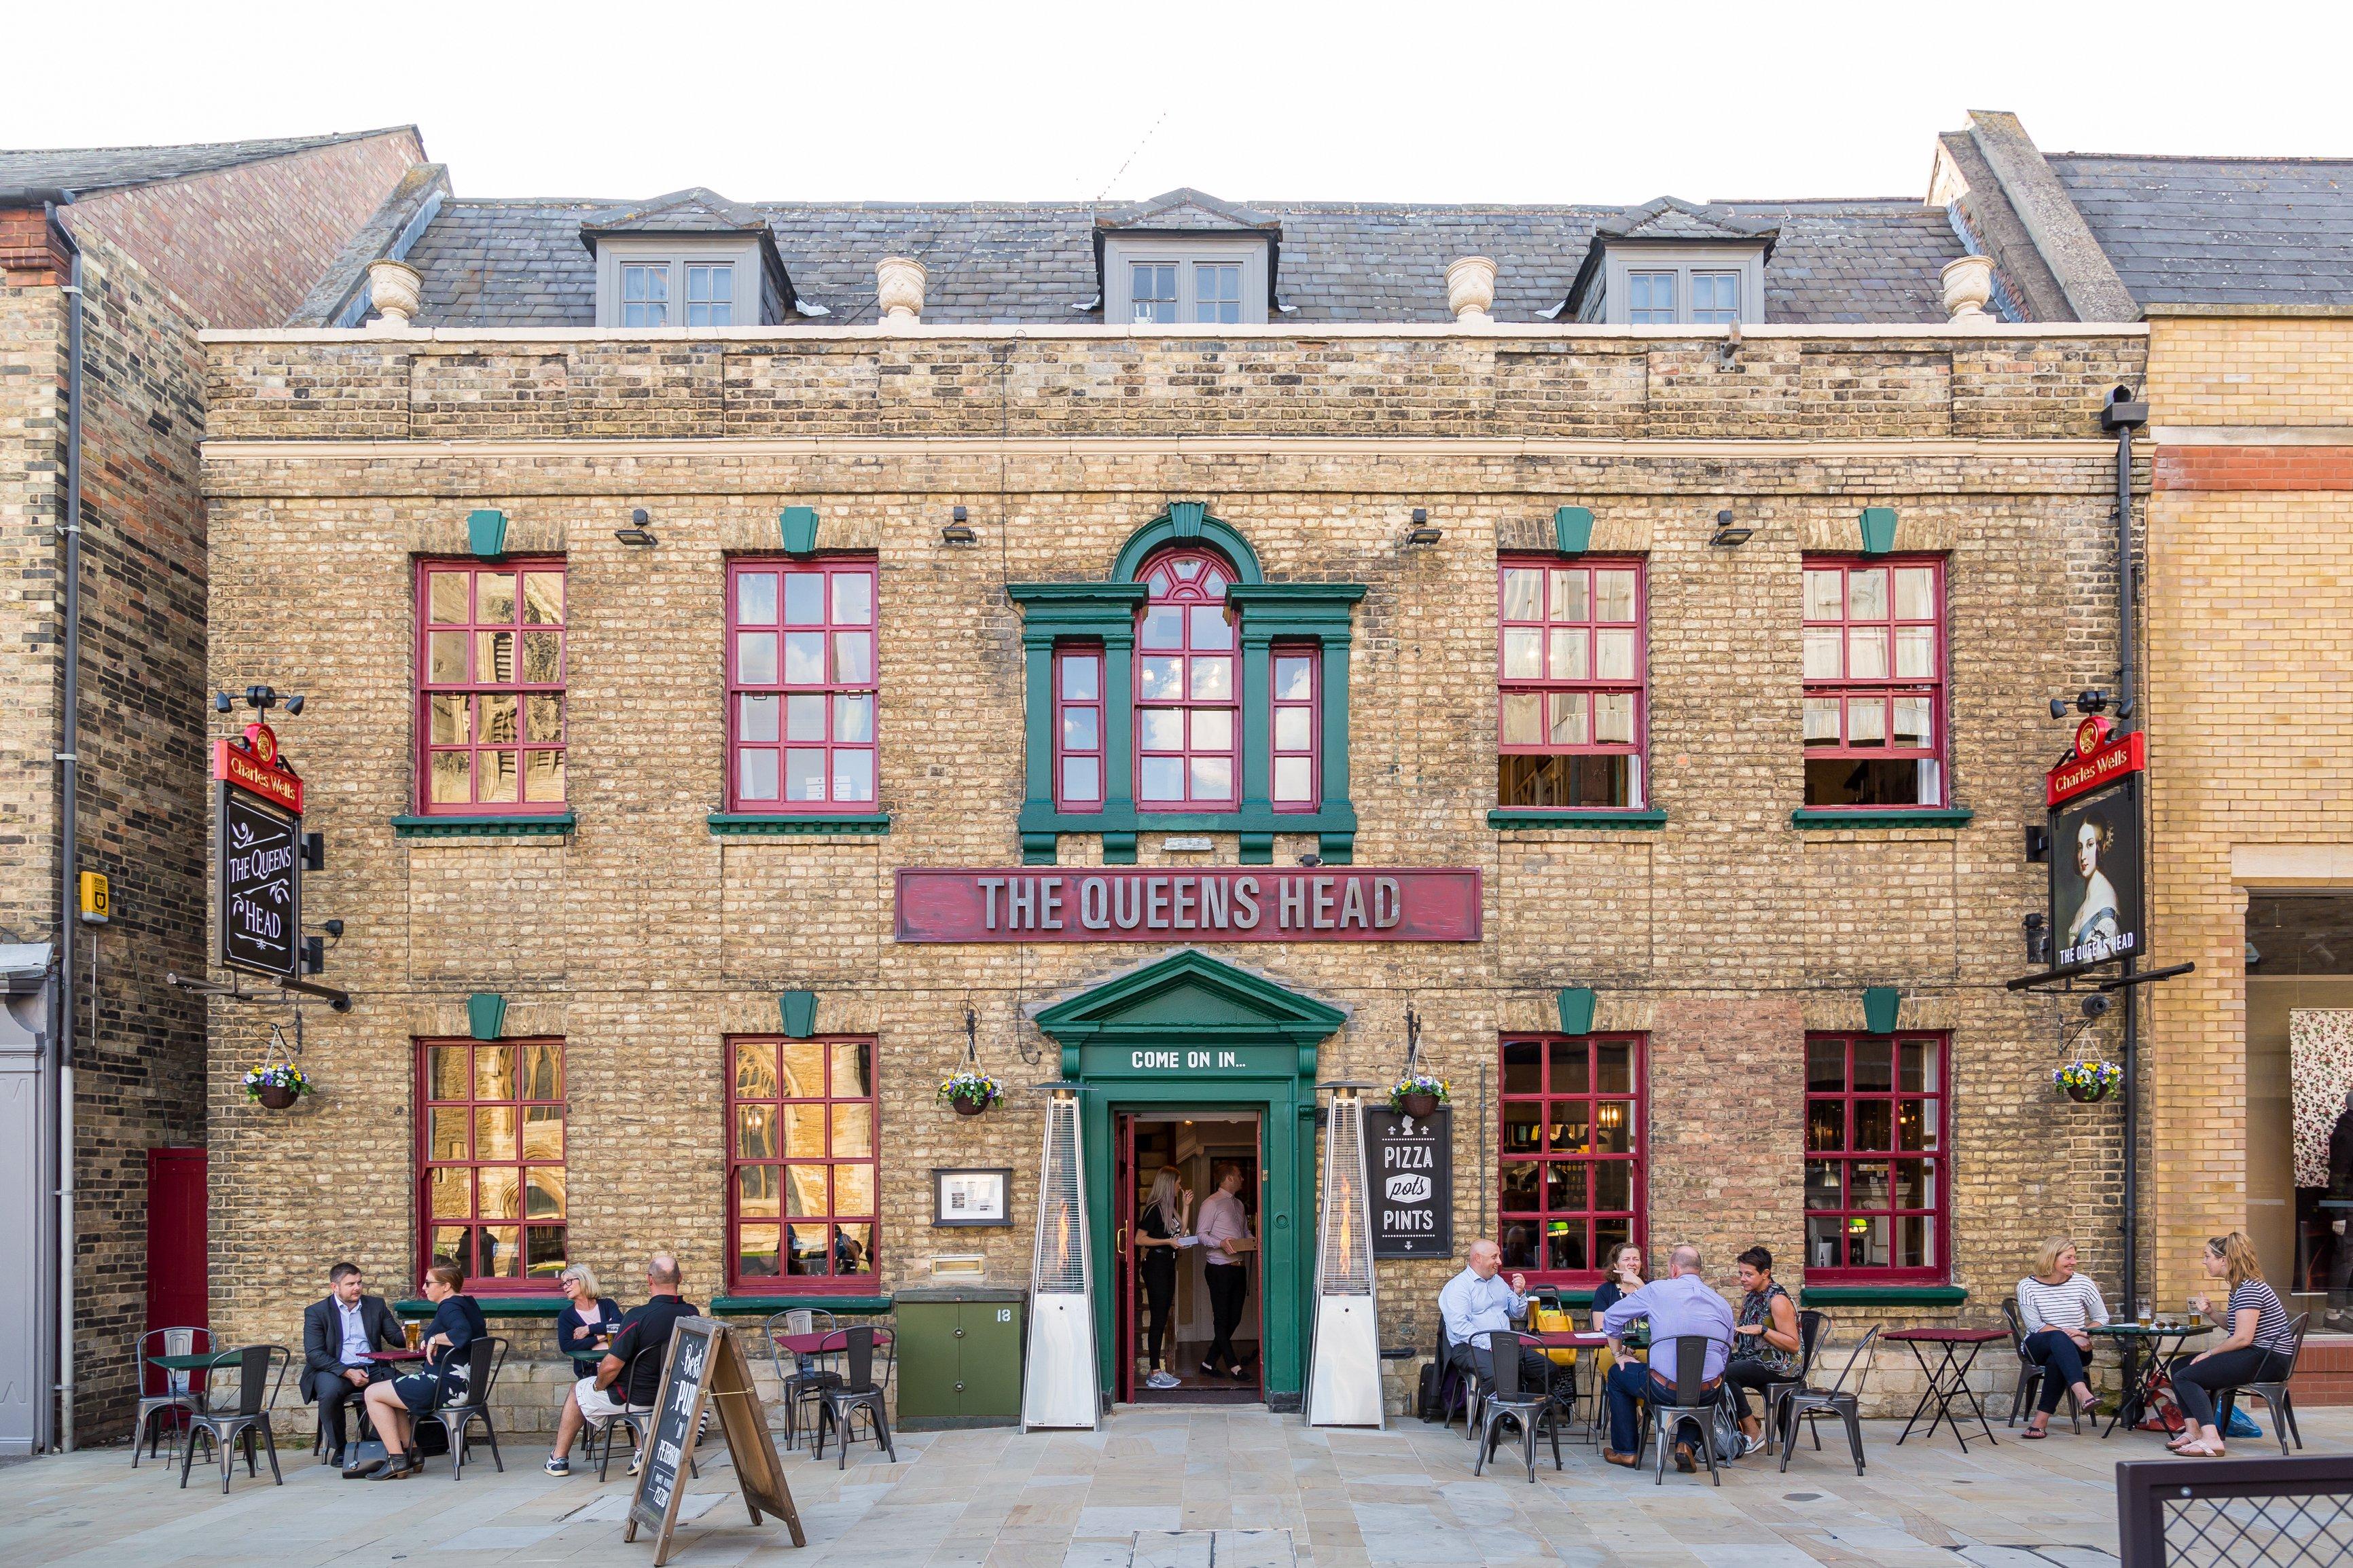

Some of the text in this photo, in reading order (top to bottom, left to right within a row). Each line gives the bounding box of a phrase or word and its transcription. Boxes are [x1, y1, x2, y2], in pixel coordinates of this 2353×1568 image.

[231, 757, 295, 800] Charles Wells
[2055, 750, 2127, 792] Charles Wells
[230, 846, 291, 883] THE QUEENS
[245, 900, 281, 938] HEAD
[977, 876, 1401, 930] THE QUEENS HEAD
[2060, 932, 2134, 964] THE QUEENS HEAD
[1132, 1051, 1180, 1068] COME
[1187, 1051, 1210, 1068] ON
[1384, 1146, 1433, 1168] PIZZA
[1388, 1176, 1426, 1199] pots
[1384, 1210, 1433, 1230] PINTS
[997, 1309, 1011, 1322] 18
[683, 1344, 702, 1379] Best
[675, 1379, 697, 1417] PUB
